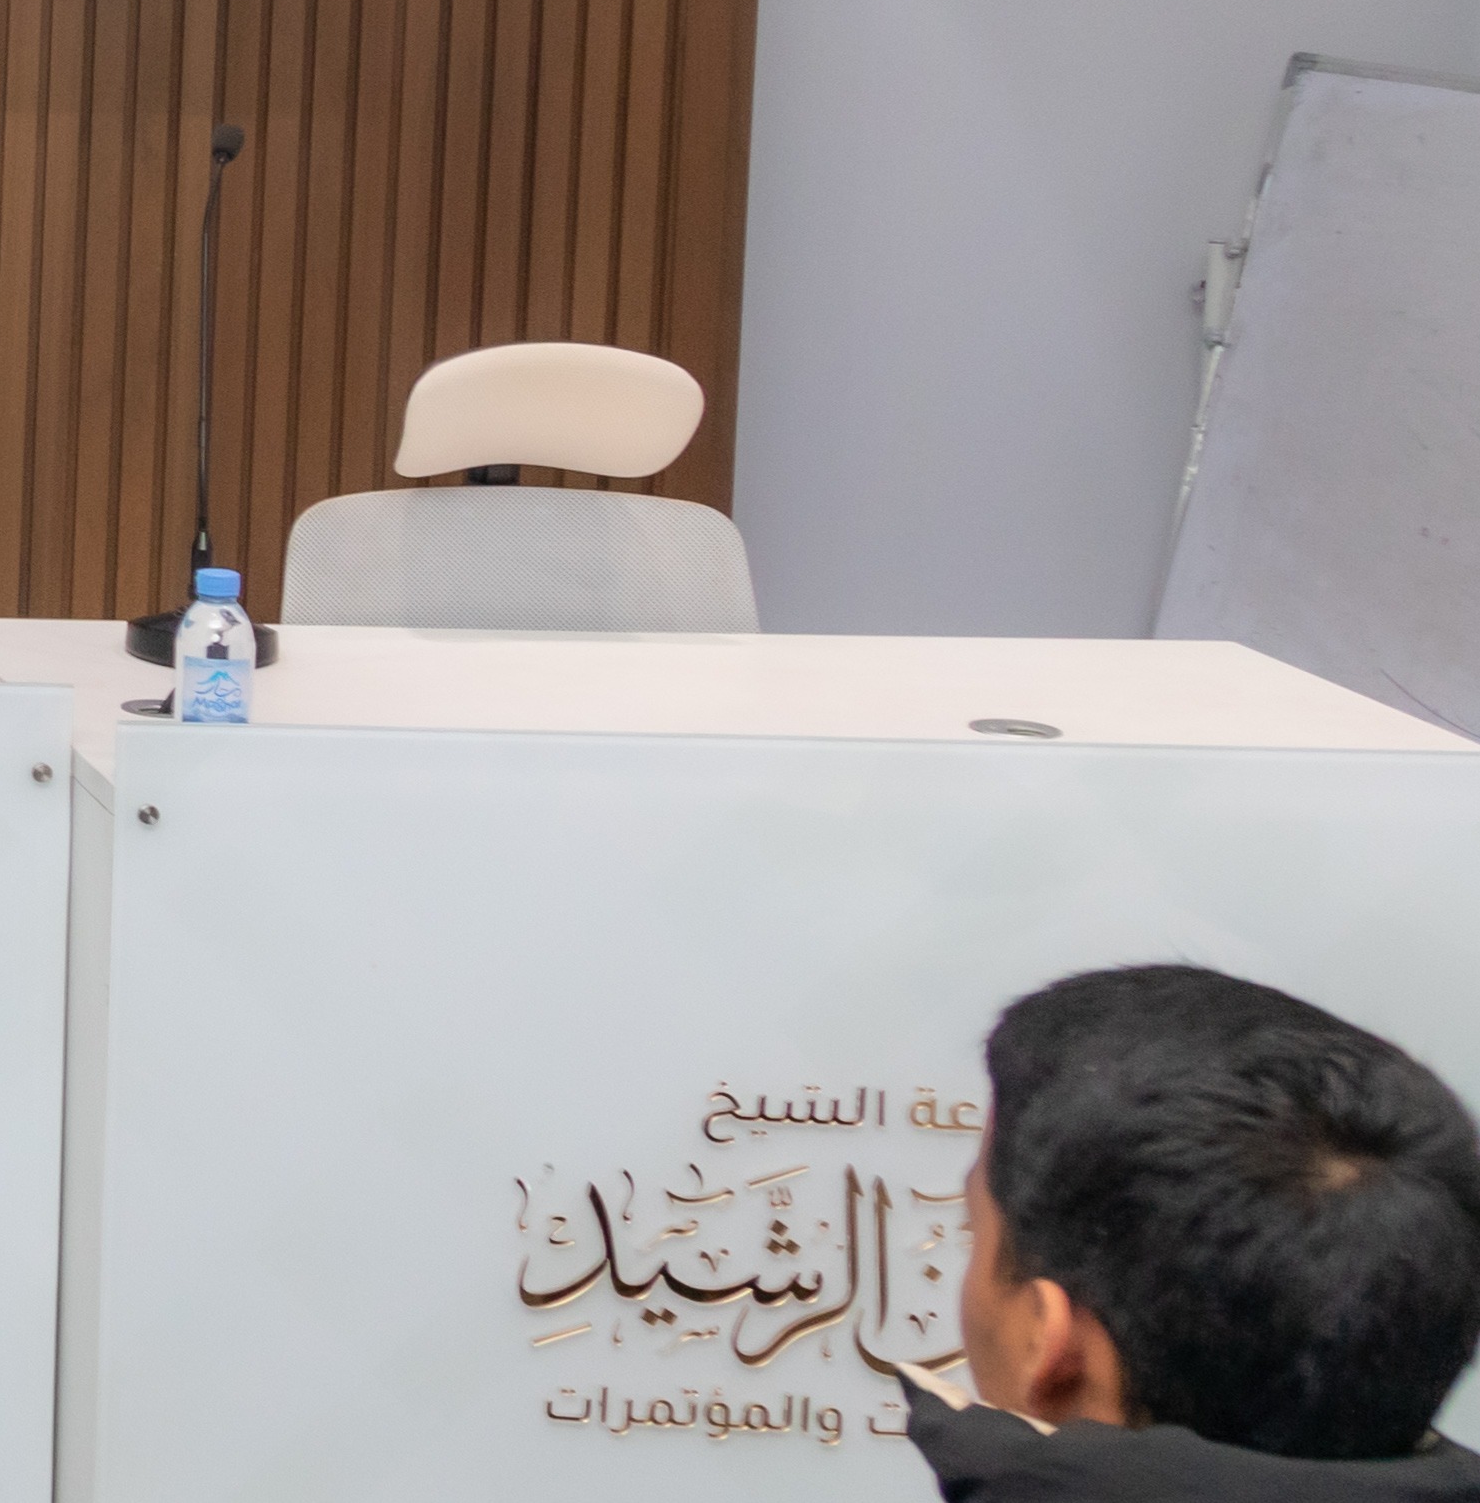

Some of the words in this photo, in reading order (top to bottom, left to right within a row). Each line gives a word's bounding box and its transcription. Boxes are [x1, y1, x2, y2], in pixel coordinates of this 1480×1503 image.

[703, 1081, 886, 1144] الشيخ
[909, 1085, 984, 1132] عة
[546, 1385, 843, 1445] والمؤتمرات
